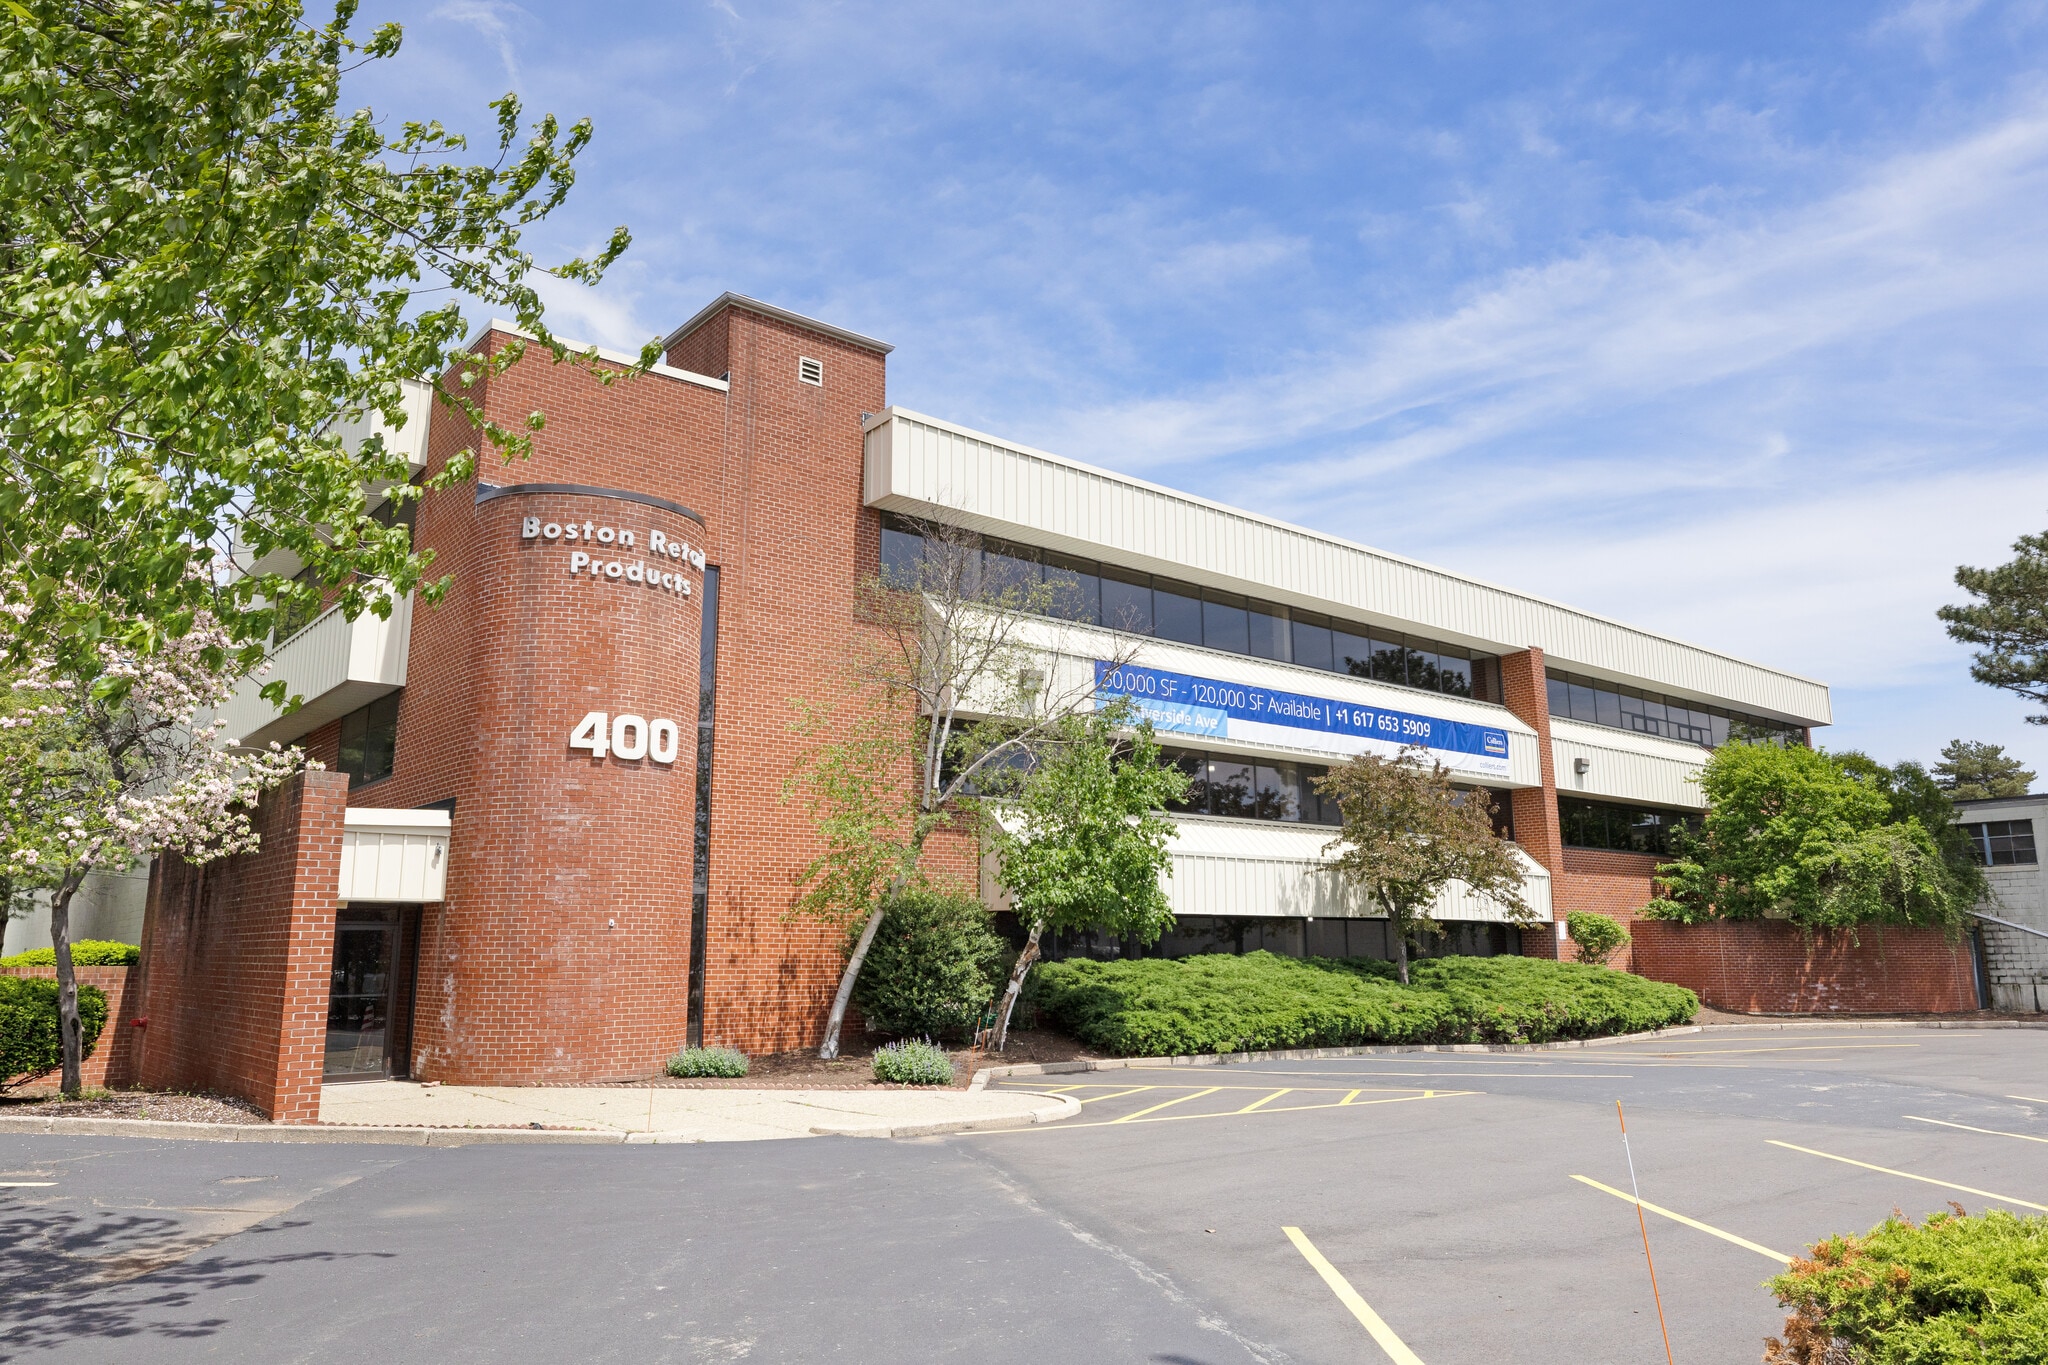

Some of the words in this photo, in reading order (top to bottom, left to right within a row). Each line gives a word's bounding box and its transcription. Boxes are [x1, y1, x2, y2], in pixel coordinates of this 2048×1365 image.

[522, 516, 635, 546] Boston
[650, 529, 706, 572] Retai
[569, 551, 691, 596] Products
[1132, 704, 1192, 727] iverside
[1194, 713, 1219, 729] Ave
[1160, 678, 1178, 697] SF
[1192, 684, 1246, 709] 120,000
[1249, 693, 1265, 711] SF
[1267, 697, 1321, 721] Available
[1335, 708, 1349, 725] +1
[1352, 710, 1375, 729] 617
[1377, 714, 1400, 733] 653
[1402, 718, 1432, 738] 5909
[569, 711, 679, 764] 400
